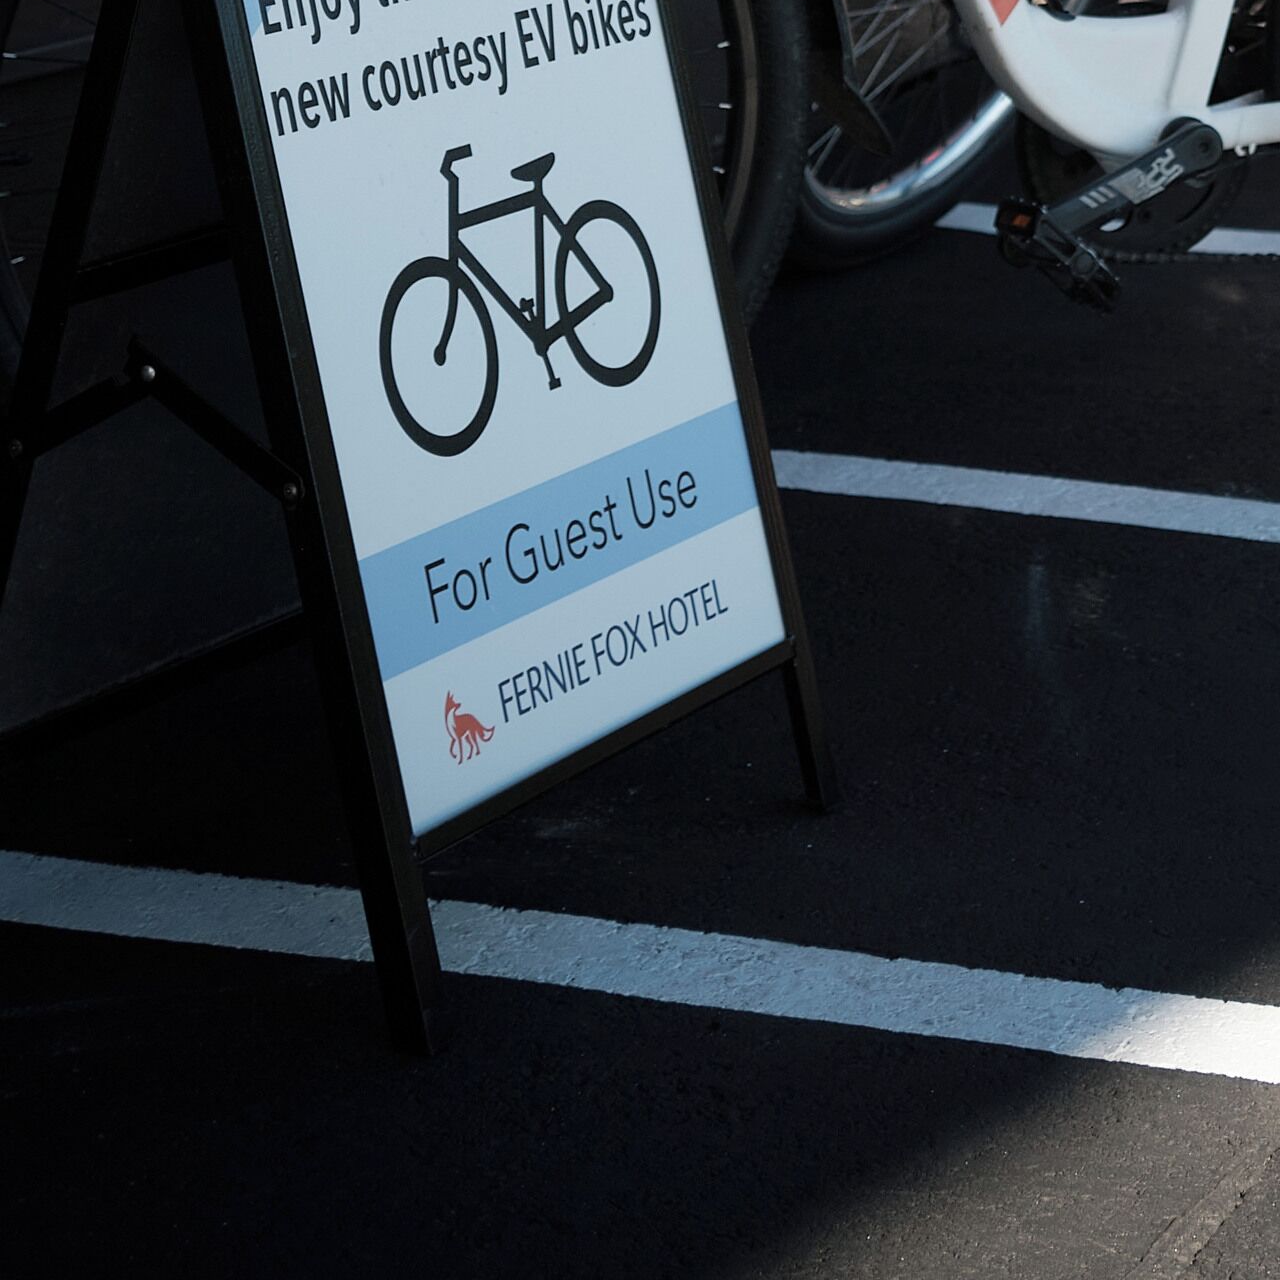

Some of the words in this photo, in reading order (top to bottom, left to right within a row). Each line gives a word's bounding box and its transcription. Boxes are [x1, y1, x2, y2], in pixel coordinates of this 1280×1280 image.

[270, 72, 351, 137] new
[362, 31, 508, 112] courtesy
[514, 3, 558, 69] EV
[423, 556, 493, 624] For
[504, 494, 624, 586] Guest
[626, 468, 699, 530] Use
[497, 643, 591, 724] FERNIE
[590, 614, 648, 676] FOX
[647, 579, 729, 648] HOTEL
